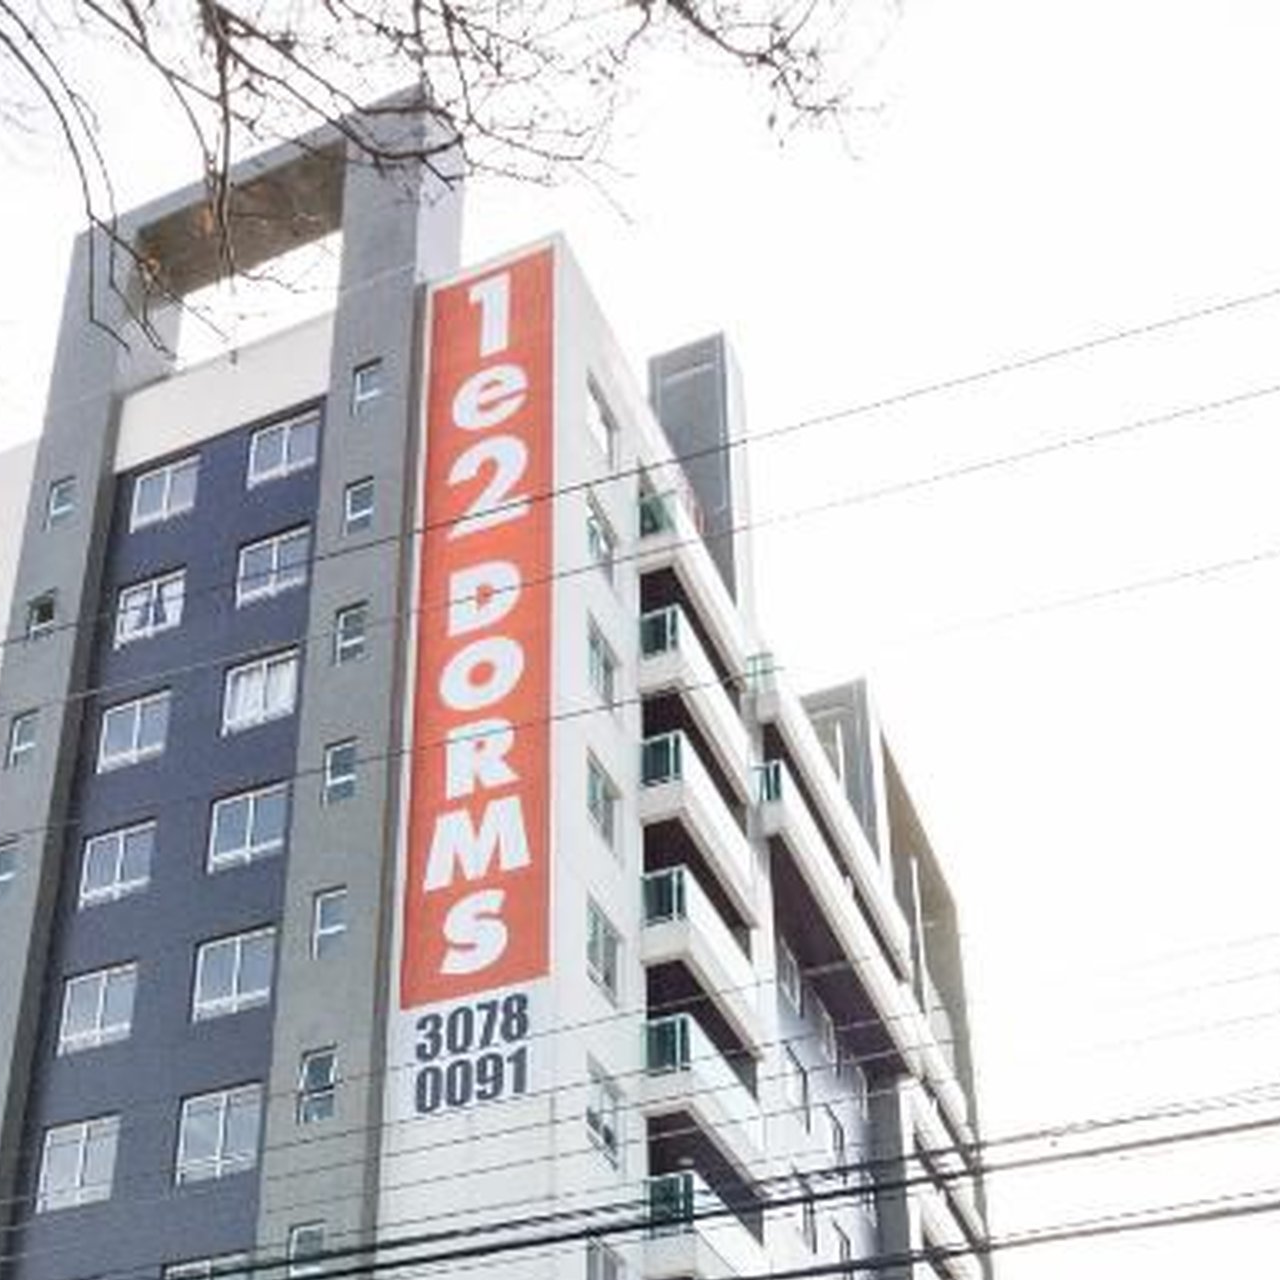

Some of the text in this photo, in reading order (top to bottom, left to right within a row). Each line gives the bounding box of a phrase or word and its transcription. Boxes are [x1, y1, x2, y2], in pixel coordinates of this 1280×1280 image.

[424, 562, 531, 976] DORMS
[415, 992, 529, 1062] 3078
[415, 1046, 527, 1114] 0091
